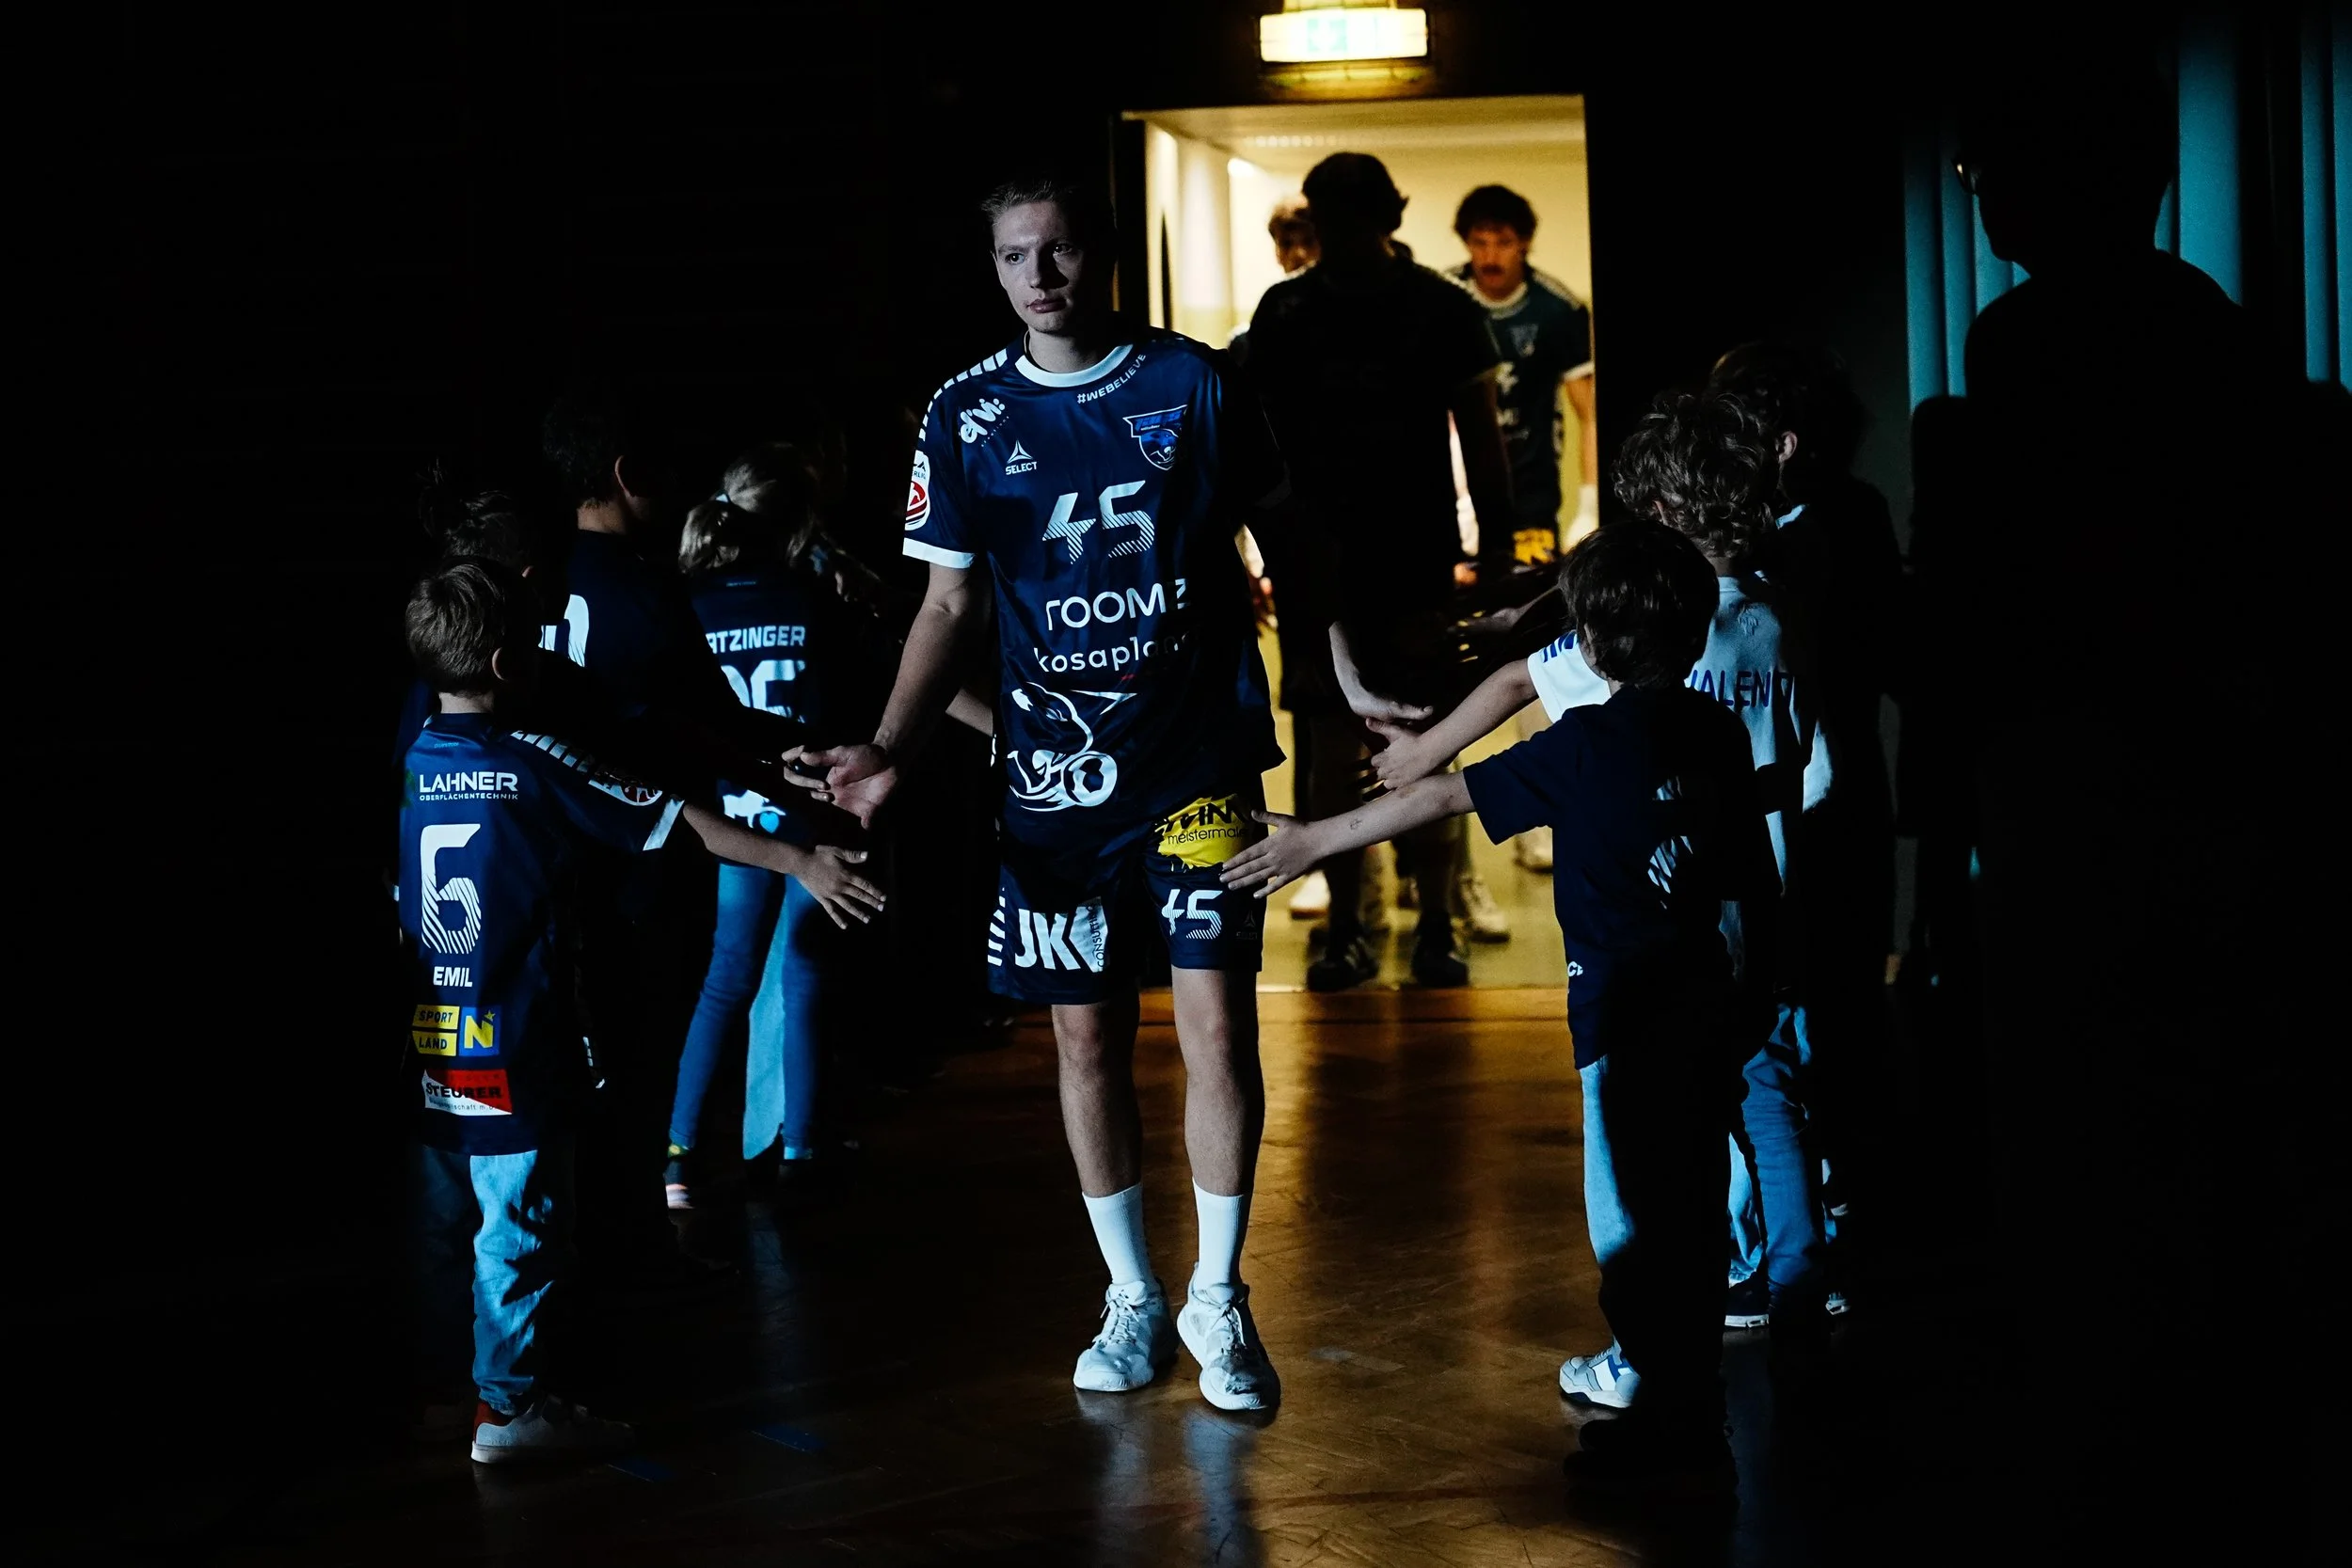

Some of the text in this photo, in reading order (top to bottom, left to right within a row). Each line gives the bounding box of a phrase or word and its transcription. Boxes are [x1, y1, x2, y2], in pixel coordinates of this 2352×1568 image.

[1077, 354, 1146, 404] #WEBELIEVE
[1005, 461, 1038, 476] SELECT
[1042, 481, 1155, 564] 45
[419, 771, 518, 793] LAHNER
[420, 823, 482, 955] 6
[1161, 889, 1223, 940] 45
[433, 965, 473, 988] EMIL
[421, 1010, 453, 1023] SPORT
[419, 1037, 447, 1050] LAND
